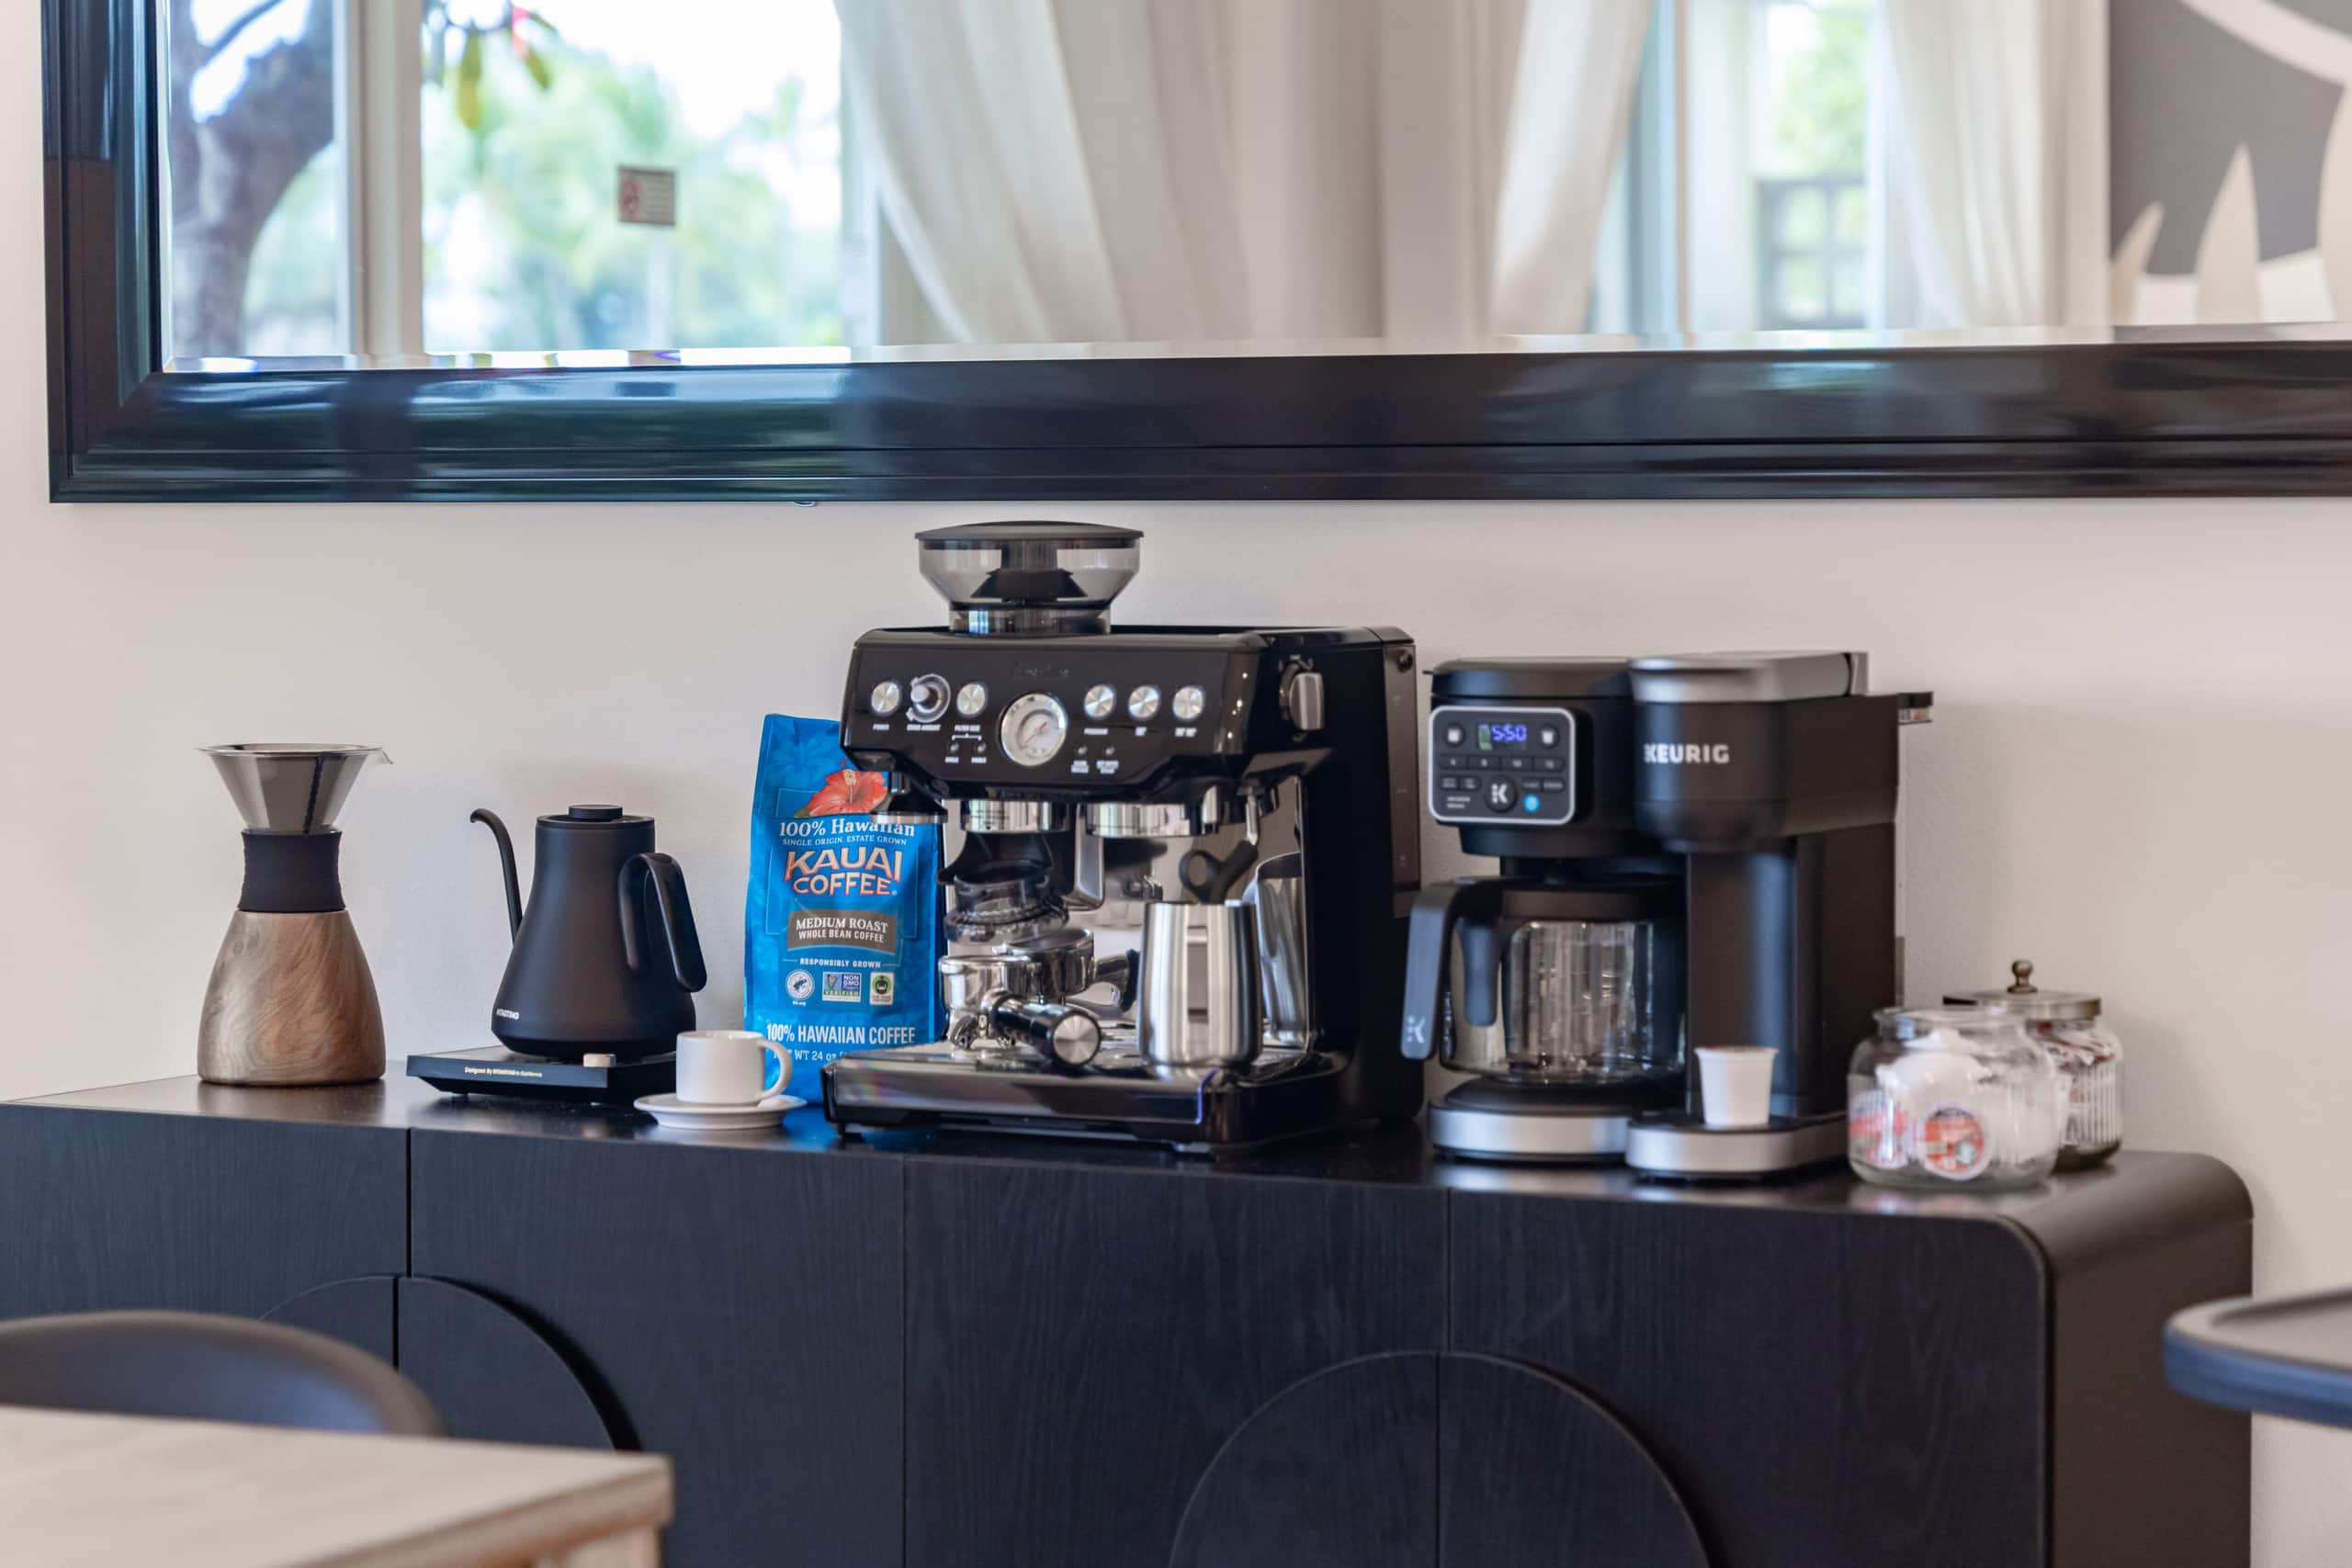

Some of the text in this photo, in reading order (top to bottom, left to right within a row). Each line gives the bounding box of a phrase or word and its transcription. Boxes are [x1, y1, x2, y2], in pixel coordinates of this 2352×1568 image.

[1644, 743, 1730, 764] KEURIG
[779, 820, 826, 837] 100%
[782, 835, 907, 846] SINGLE ORIGIN ESTATE GROWN
[785, 846, 903, 882] KAUAI
[793, 871, 892, 897] COFFEE
[796, 917, 888, 933] MEDIUM ROAST
[798, 930, 885, 942] WHOLE BEAN COFFEE
[799, 957, 881, 968] RESPONSIBLY GROWN
[766, 1023, 916, 1044] 100% HAWAIIAN COFFEE
[794, 1049, 809, 1060] WT
[811, 1050, 823, 1061] 24
